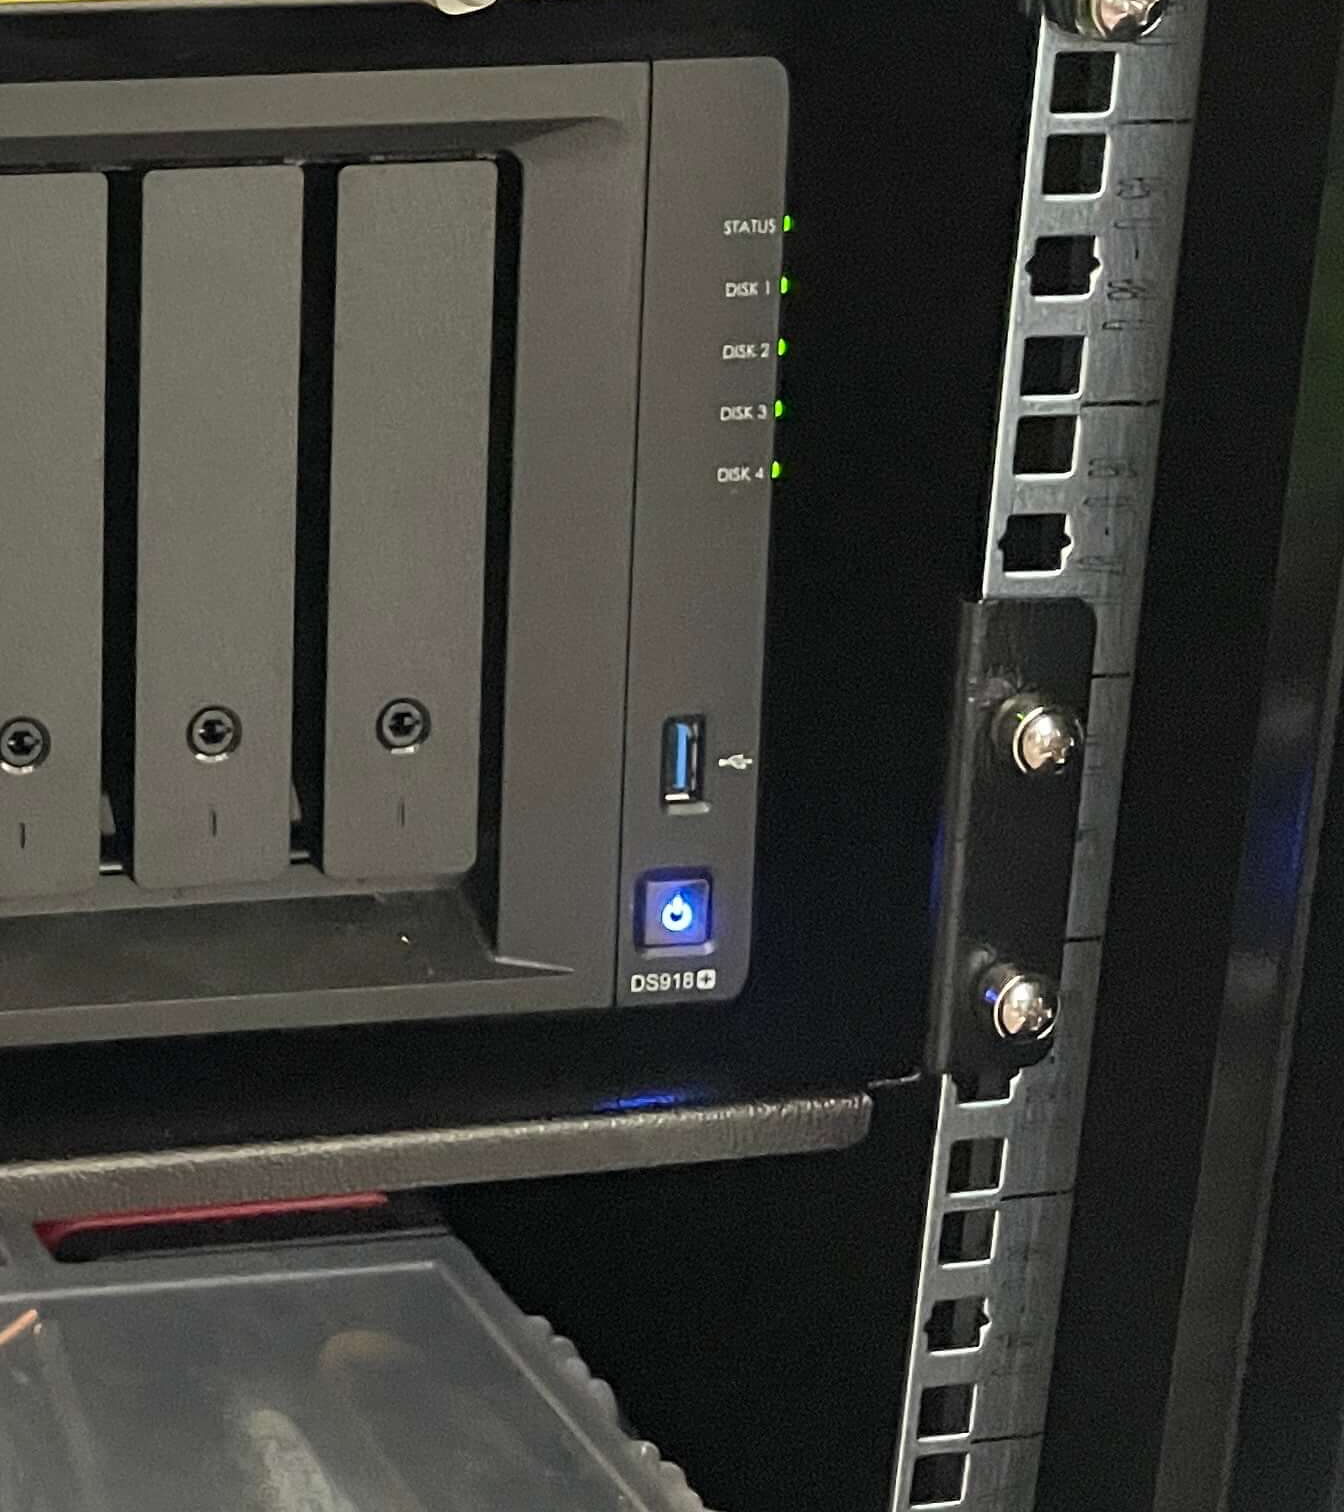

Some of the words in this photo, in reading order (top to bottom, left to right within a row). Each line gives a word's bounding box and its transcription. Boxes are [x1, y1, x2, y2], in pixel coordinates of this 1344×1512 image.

[723, 218, 777, 235] STATUS
[725, 281, 758, 297] DISK
[765, 280, 770, 295] 1
[722, 344, 756, 360] DISK
[760, 343, 770, 358] 2
[720, 406, 753, 421] DISK
[758, 404, 768, 419] 3
[716, 468, 751, 483] DISK
[754, 466, 764, 479] 4
[631, 969, 716, 992] DS918+
